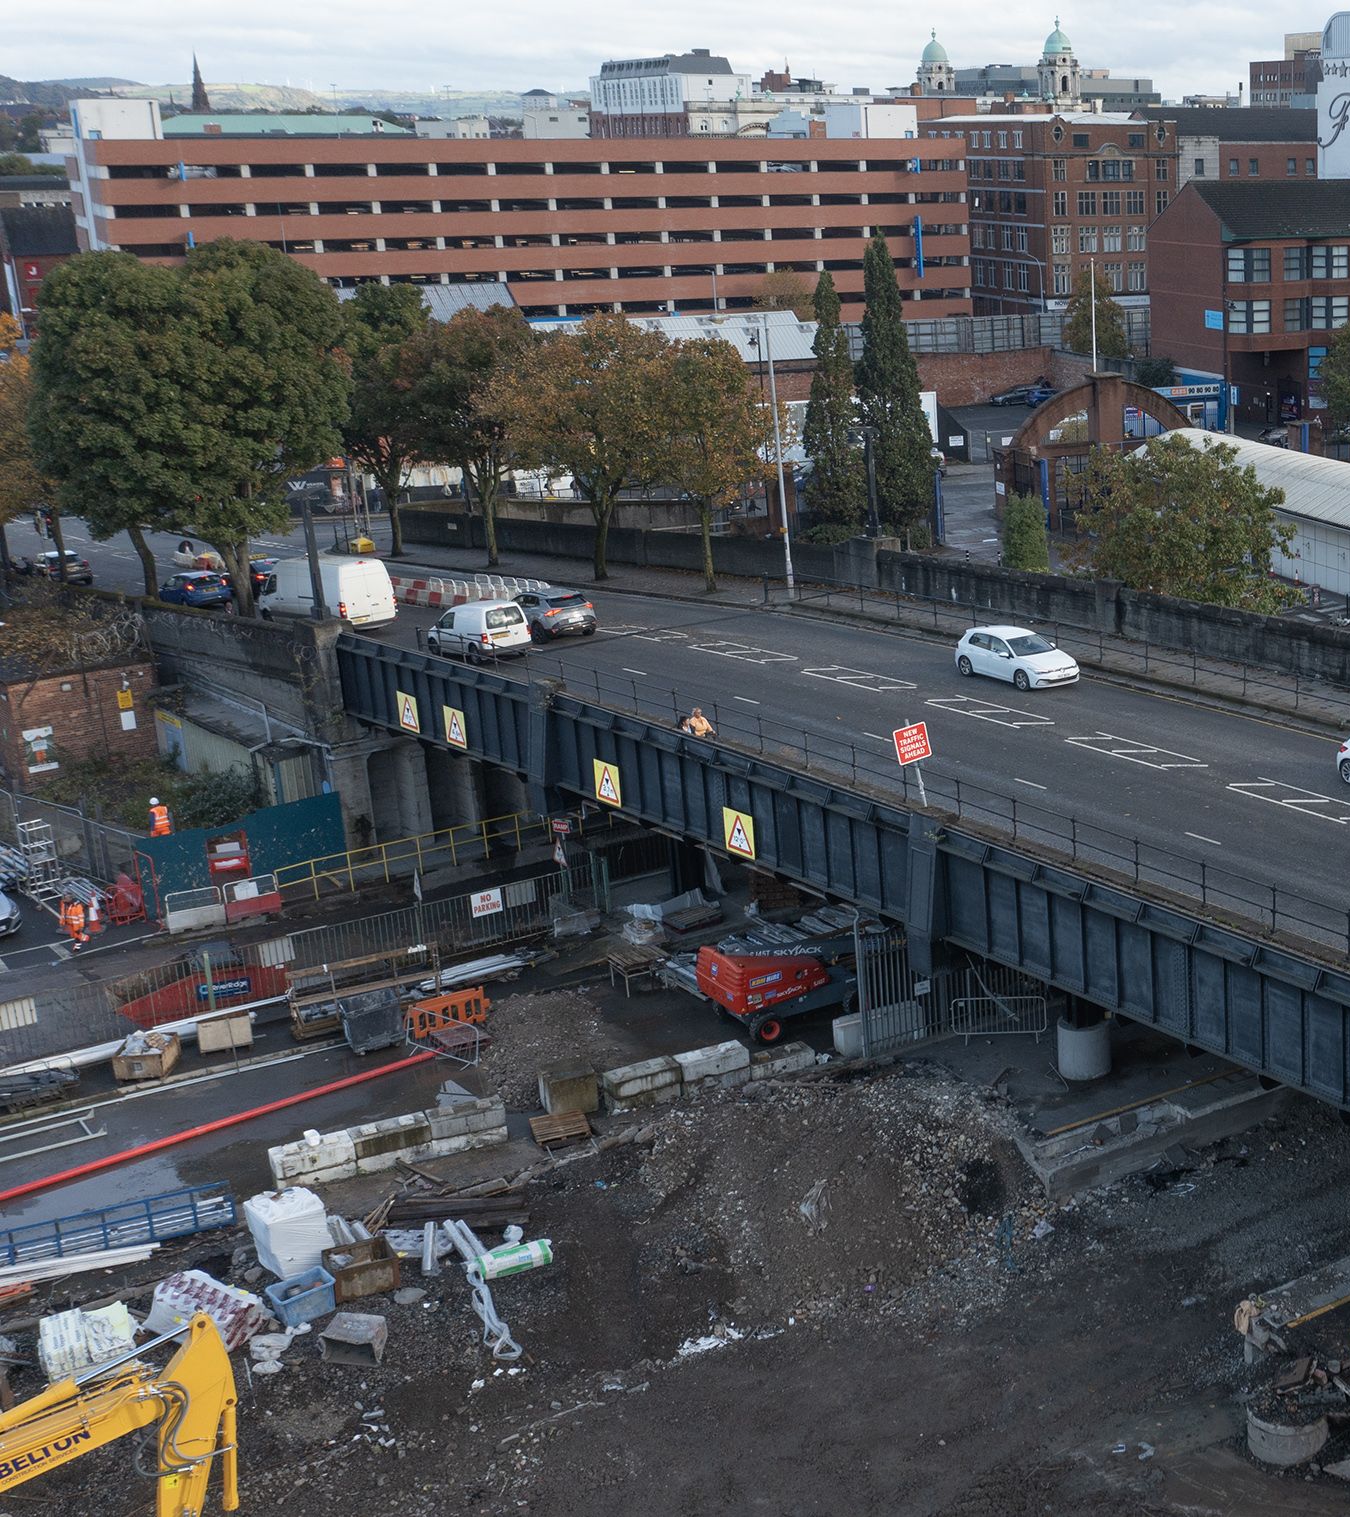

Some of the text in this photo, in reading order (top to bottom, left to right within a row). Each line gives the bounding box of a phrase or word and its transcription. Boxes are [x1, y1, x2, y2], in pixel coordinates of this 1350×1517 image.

[899, 733, 924, 747] TRAFFIC
[903, 728, 918, 738] NEW
[900, 740, 927, 754] SIGNALS
[904, 747, 926, 760] AHEAD
[480, 893, 492, 904] NO
[473, 900, 501, 914] PARKING
[0, 1430, 92, 1479] BELTON
